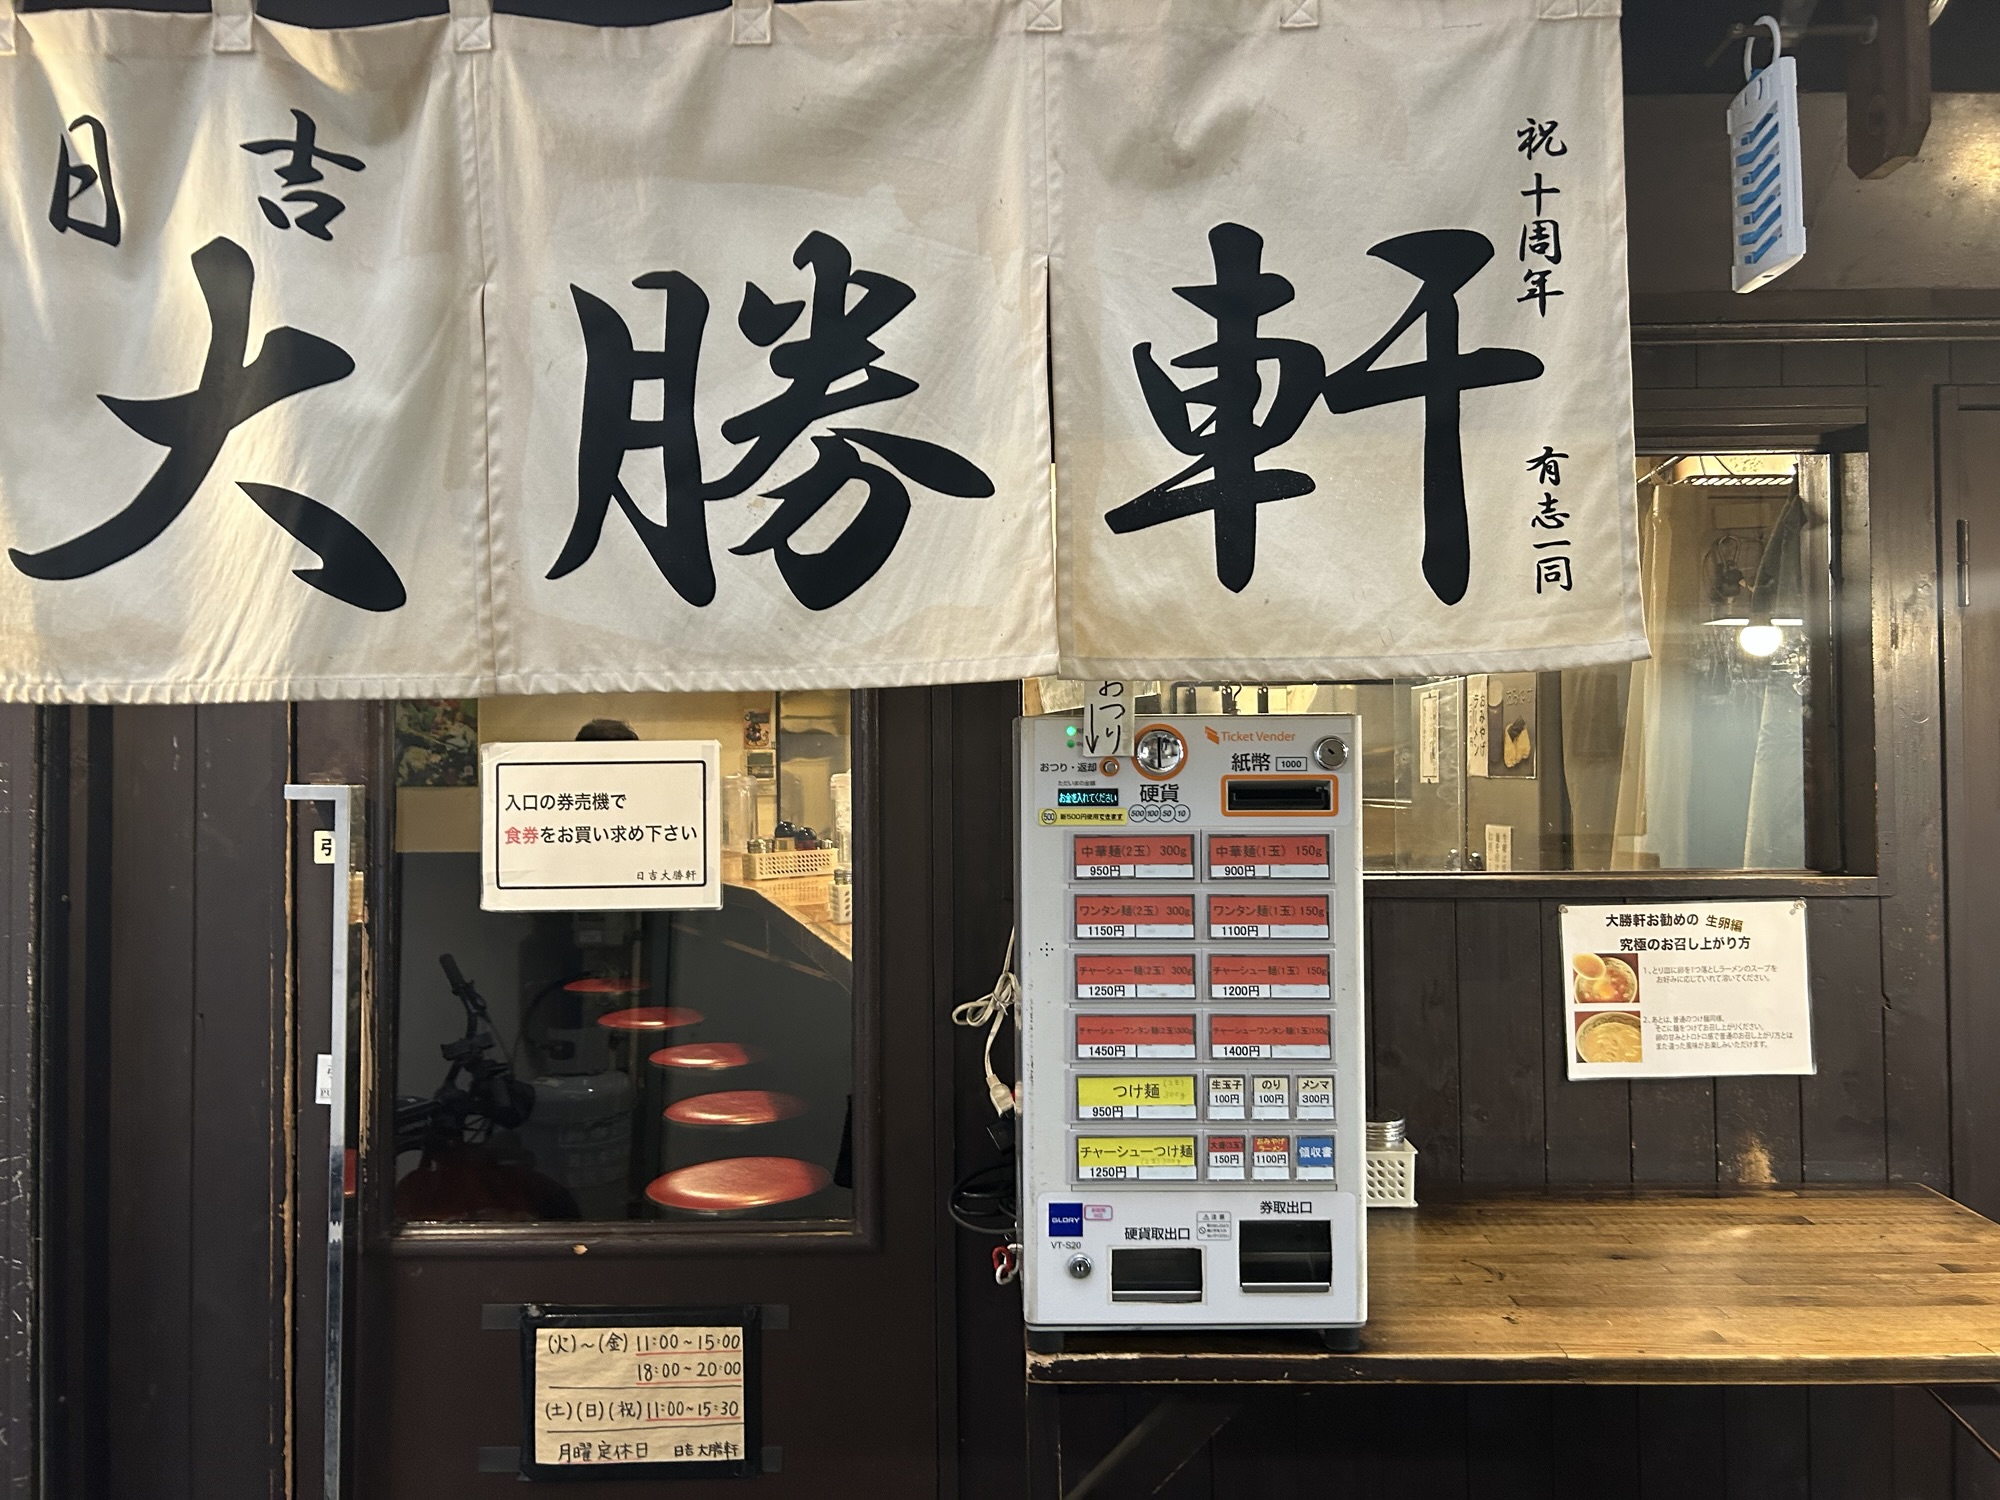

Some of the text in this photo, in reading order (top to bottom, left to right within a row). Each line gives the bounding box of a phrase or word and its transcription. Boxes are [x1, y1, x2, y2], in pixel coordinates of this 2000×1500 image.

[48, 108, 366, 247] 日吉
[1516, 117, 1568, 318] 祝十周年
[8, 222, 1545, 612] 大勝軒
[1525, 446, 1573, 594] 有志一同
[1099, 681, 1125, 754] おつり
[1221, 731, 1295, 742] Ticket Vender
[1040, 763, 1097, 773] おつり・返却
[1231, 753, 1302, 772] 紙幣 1000
[1059, 792, 1118, 804] お金を入れてください
[1140, 784, 1180, 803] 硬貨
[505, 793, 627, 811] 入口の券売機で
[1043, 812, 1055, 821] 500
[1131, 809, 1186, 817] 500 100 50 10
[505, 825, 698, 844] 食券をお買い求め下さい
[1160, 845, 1187, 859] 300g
[1296, 845, 1322, 859] 150g
[636, 869, 697, 882] 日吉大勝軒
[1089, 865, 1121, 877] 950円
[1224, 865, 1256, 877] 900円
[1167, 905, 1191, 918] 300g
[1300, 905, 1325, 918] 150g
[1605, 913, 1744, 933] 大勝軒お勧めの 生卵編
[1088, 925, 1125, 937] 1150円
[1221, 925, 1258, 937] 1100円
[1620, 936, 1751, 951] 究極のお召し上がり方
[1088, 985, 1125, 997] 1250円
[1222, 985, 1260, 997] 1200円
[1088, 1045, 1126, 1057] 1450円
[1223, 1045, 1260, 1057] 1400円
[1113, 1083, 1161, 1099] つけ麺
[1211, 1080, 1242, 1090] 生玉子
[1261, 1080, 1281, 1090] のり
[1302, 1080, 1330, 1090] メンマ
[1214, 1094, 1240, 1104] 100円
[1259, 1094, 1284, 1104] 100円
[1302, 1094, 1329, 1104] 300円
[1092, 1106, 1123, 1118] 950円
[1080, 1144, 1193, 1158] チャーシューつけ麺
[1298, 1146, 1333, 1158] 領収書
[1214, 1154, 1240, 1164] 150円
[1256, 1154, 1286, 1164] 1100円
[1090, 1166, 1126, 1178] 1250円
[1260, 1200, 1312, 1214] 券取出口
[1051, 1216, 1081, 1224] GLORY
[1124, 1227, 1190, 1241] 硬貨取出口
[1051, 1241, 1082, 1249] VT-S20
[558, 1441, 649, 1463] 月曜定休日
